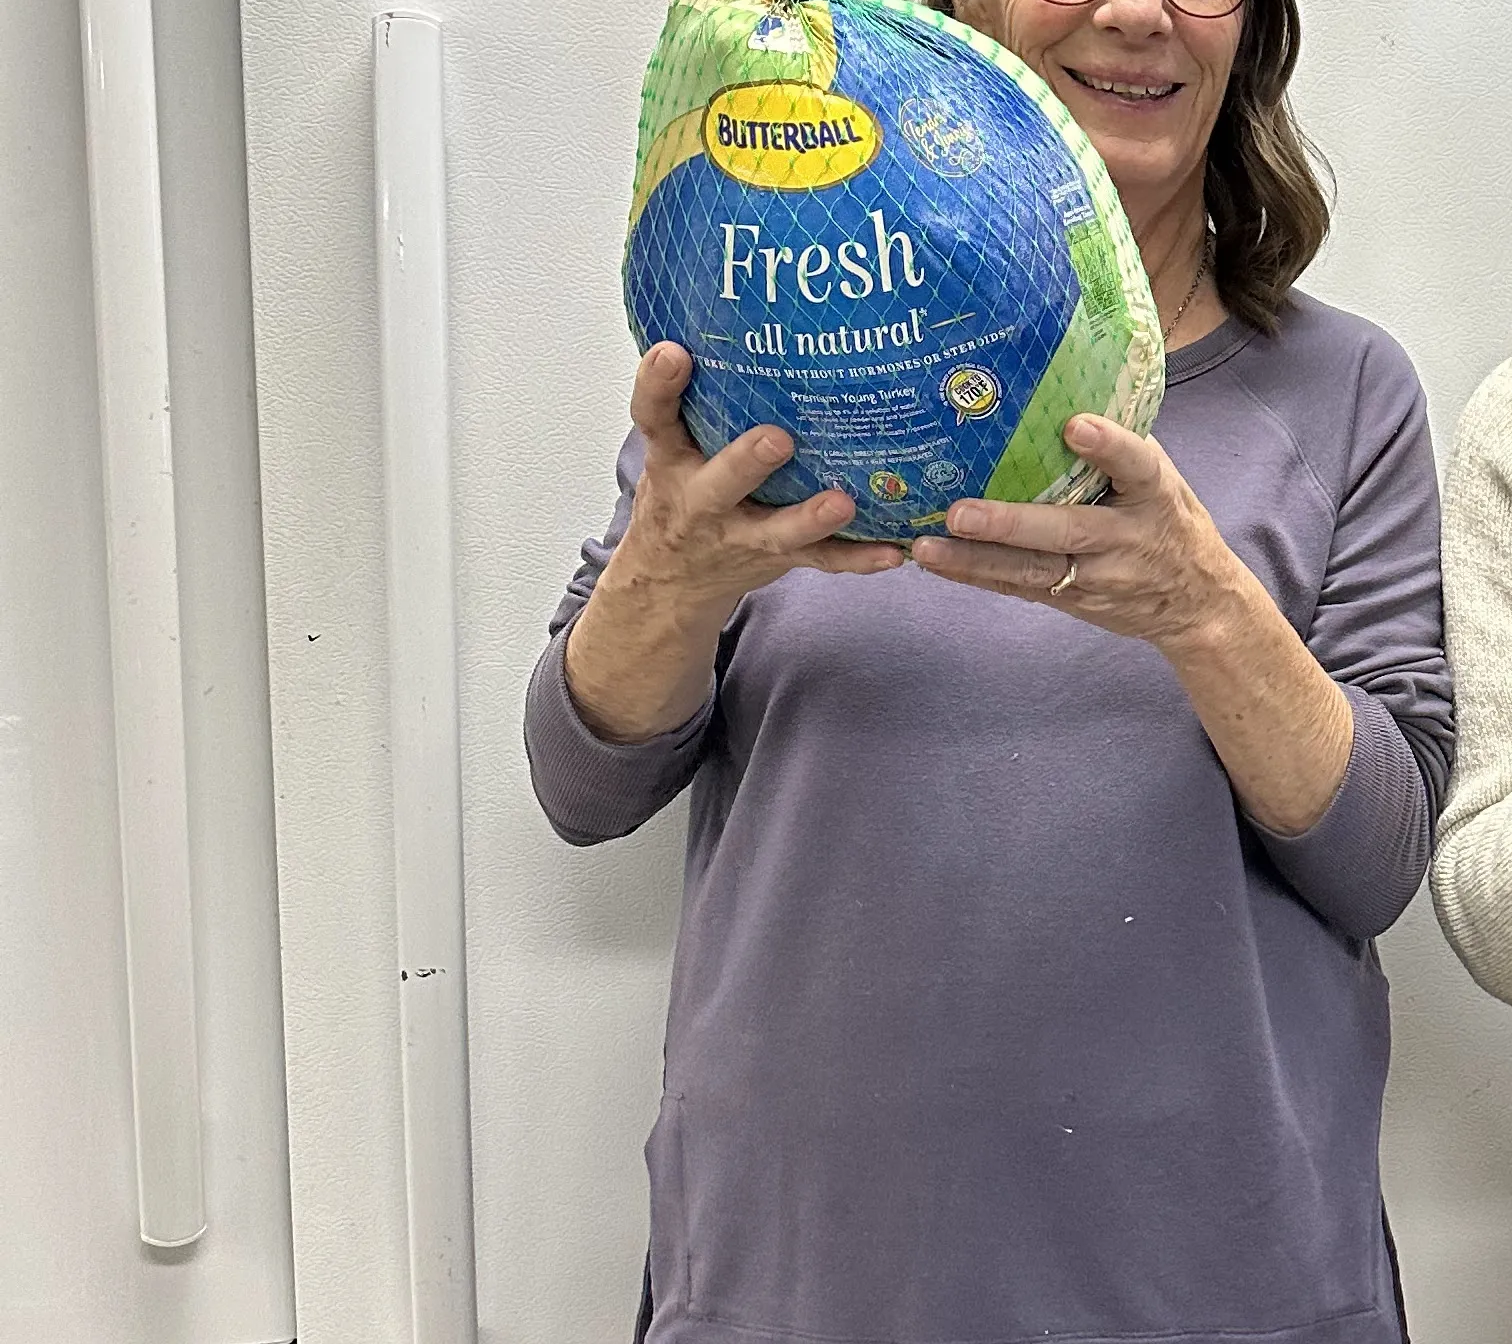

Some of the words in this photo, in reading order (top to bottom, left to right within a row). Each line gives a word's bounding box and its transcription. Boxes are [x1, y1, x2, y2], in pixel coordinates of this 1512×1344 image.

[717, 112, 864, 155] BUTTERBALL
[719, 208, 926, 304] Fresh
[744, 323, 788, 356] all
[736, 363, 782, 378] RAISED
[783, 367, 845, 379] WITHOUT
[847, 358, 921, 379] HORMONES
[923, 351, 942, 365] OR
[790, 390, 839, 405] Premium
[841, 391, 877, 405] Young
[879, 386, 916, 401] Turkey
